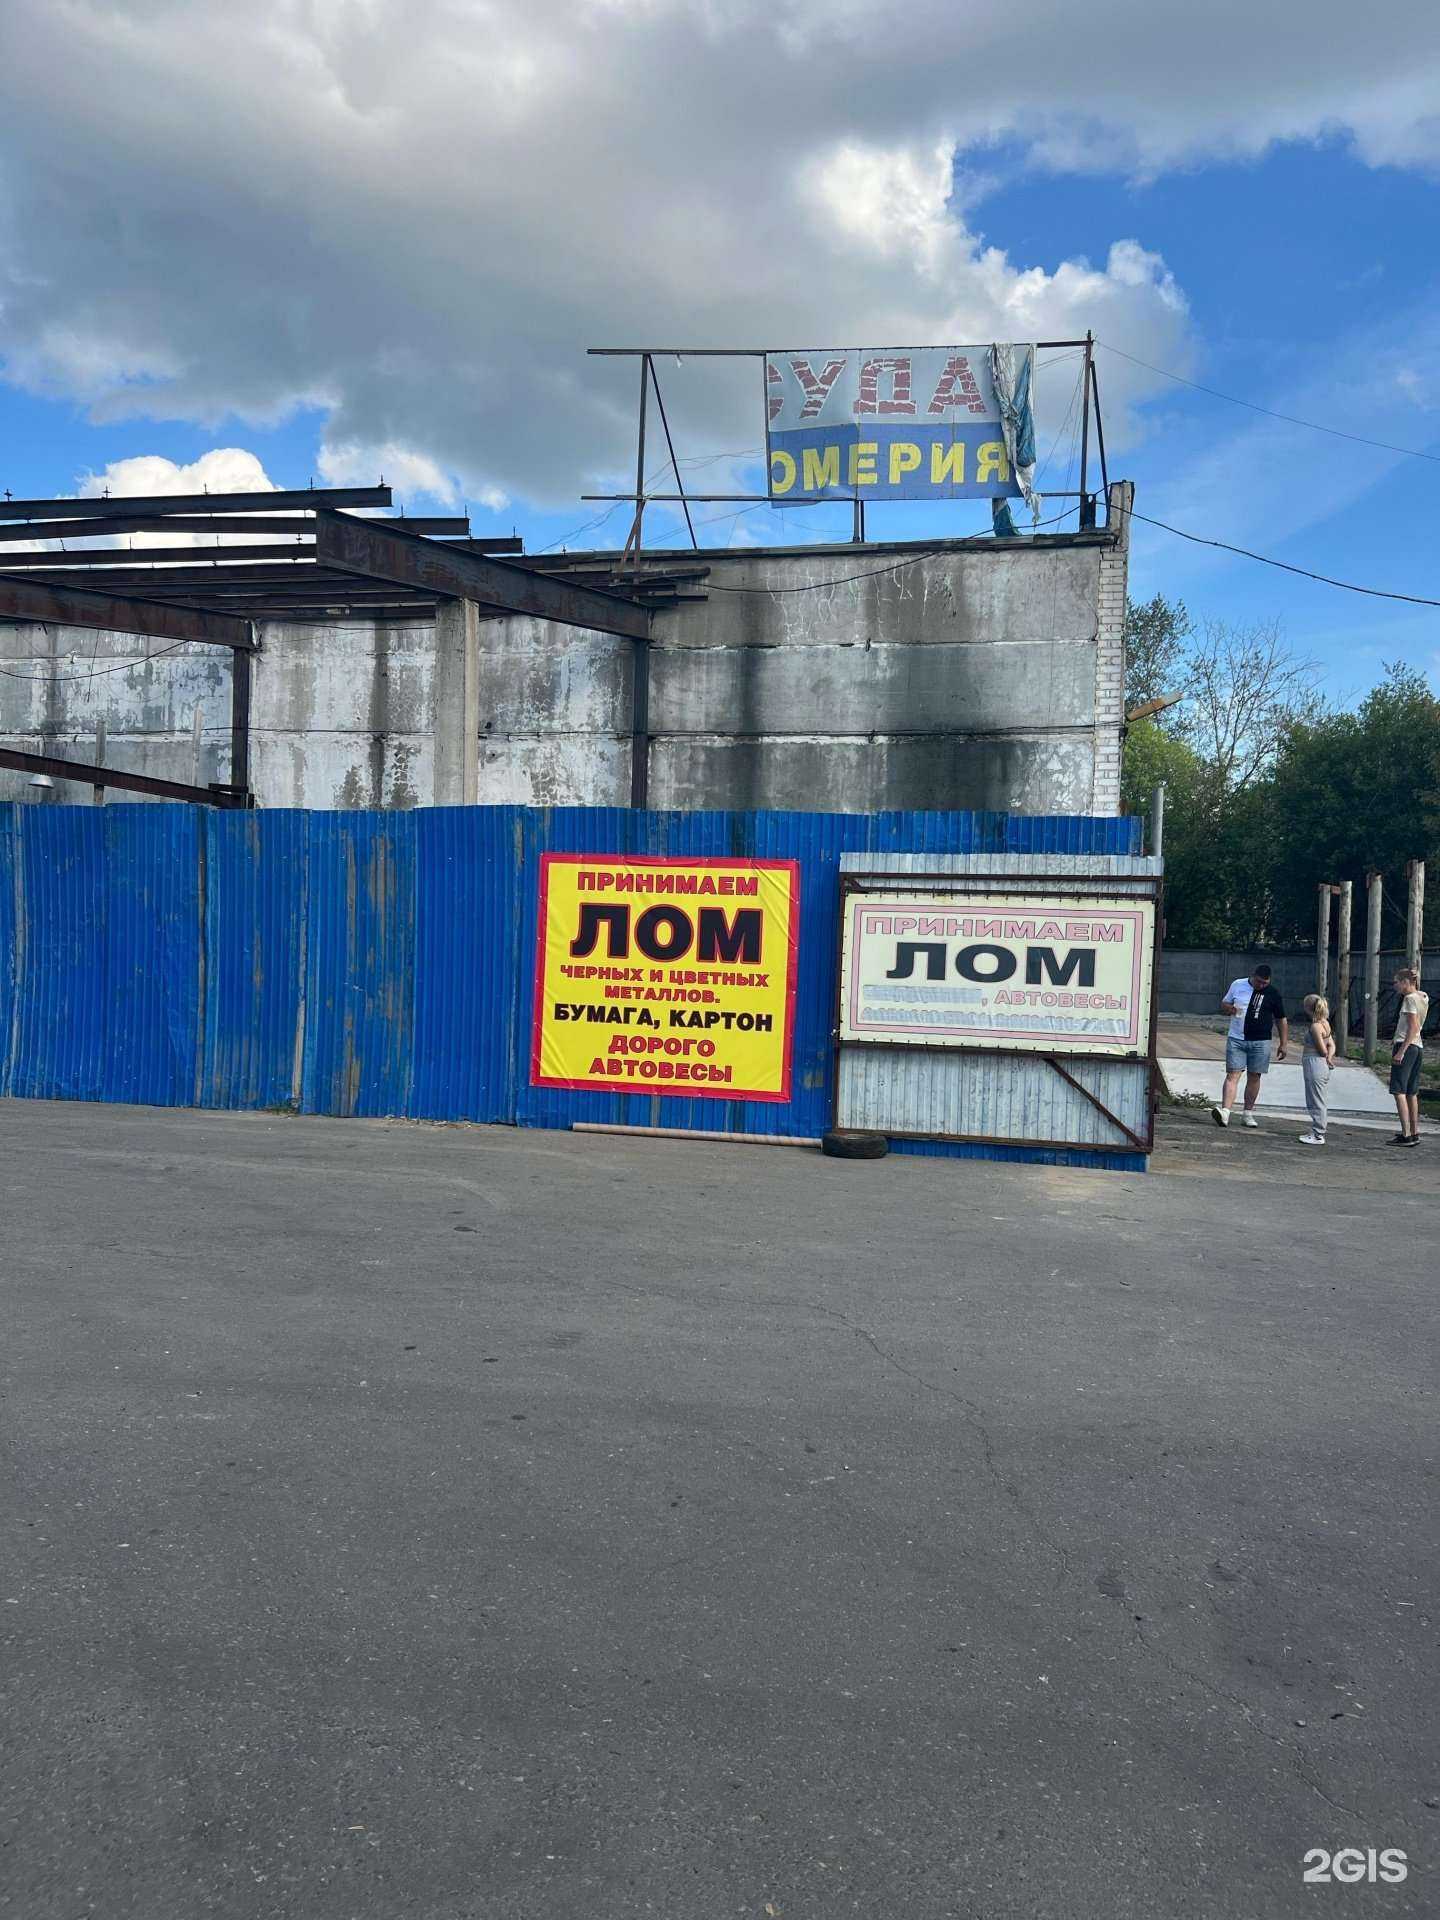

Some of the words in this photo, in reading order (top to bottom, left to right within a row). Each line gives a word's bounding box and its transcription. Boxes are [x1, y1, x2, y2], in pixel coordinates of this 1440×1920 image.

[577, 871, 759, 896] ПРИНИМАЕМ
[569, 902, 764, 964] ЛОМ
[865, 916, 1124, 943] ПРИНИМАЕМ
[560, 964, 644, 982] ЧЕРНЫХ
[649, 969, 663, 983] И
[669, 970, 769, 987] ЦВЕТНЫХ
[886, 941, 1097, 987] ЛОМ
[604, 985, 721, 1004] МЕТАЛЛОВ.
[994, 989, 1127, 1010] АВТОВЕСЫ
[554, 1003, 661, 1029] БУМАГА,
[669, 1009, 773, 1032] КАРТОН
[608, 1035, 716, 1057] ДОРОГО
[588, 1058, 732, 1082] АВТОВЕСЫ
